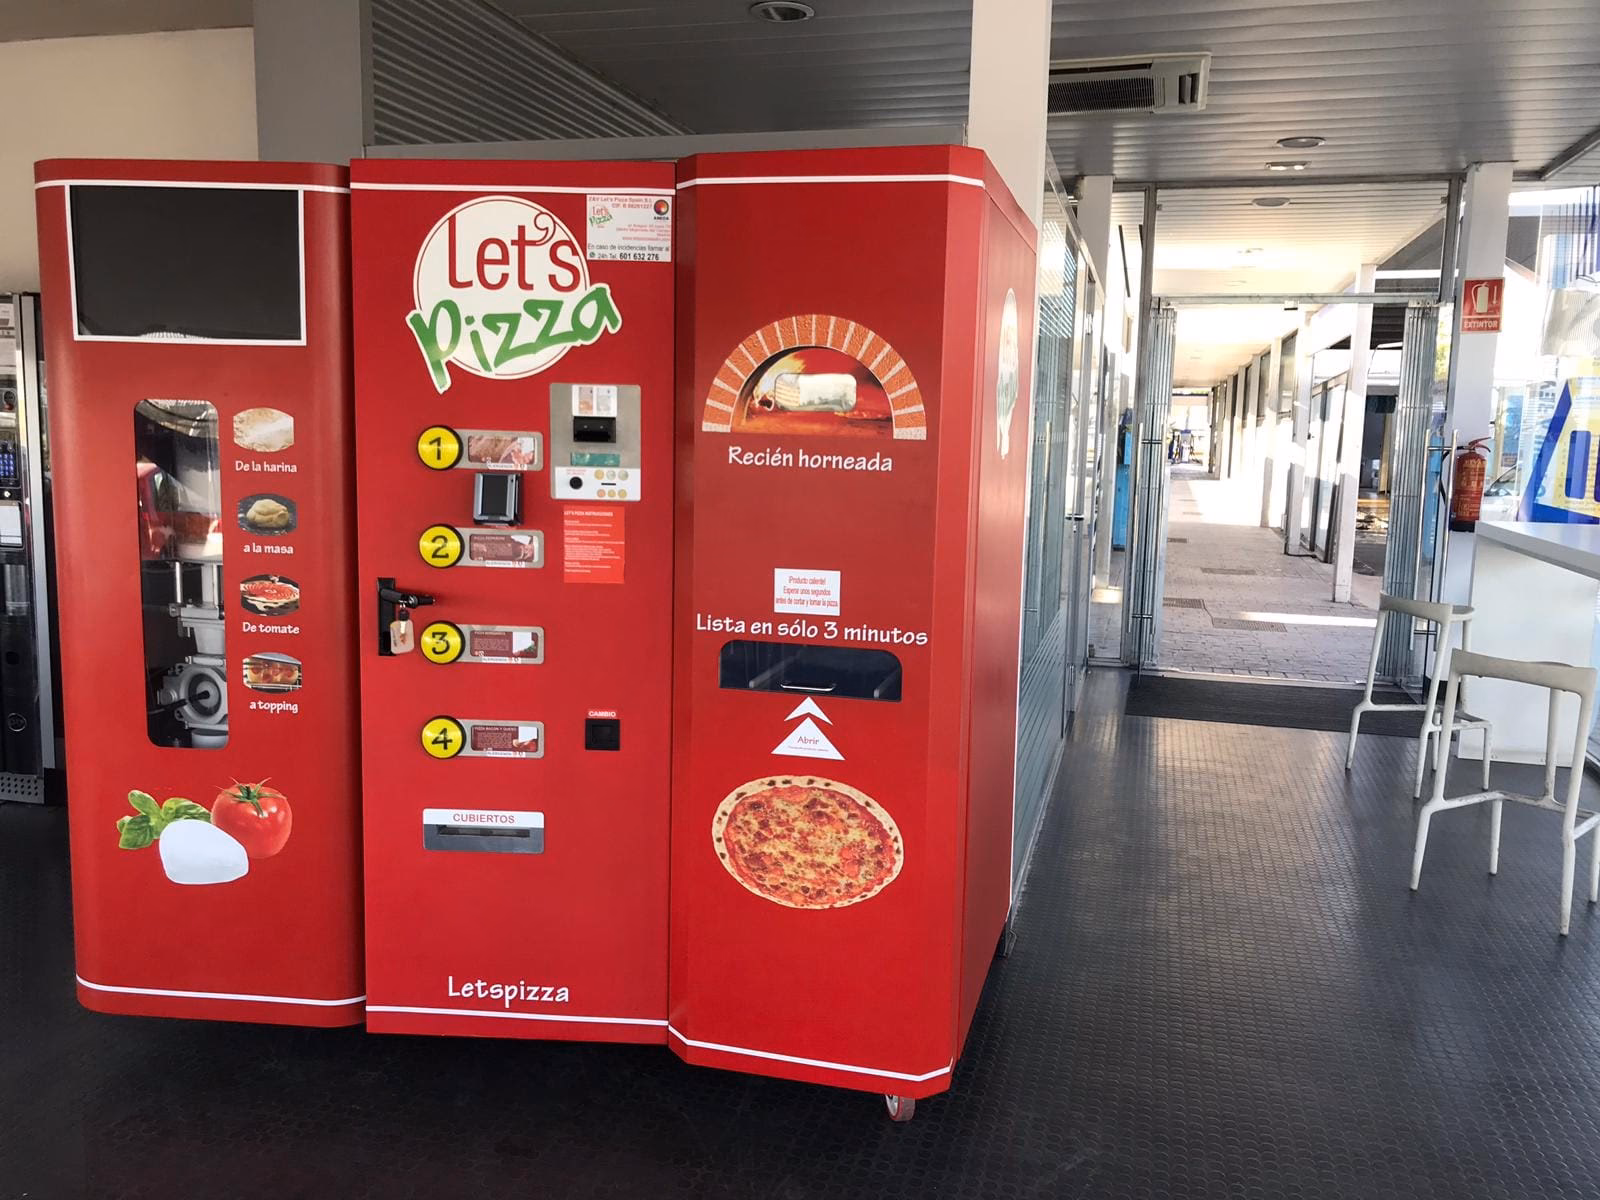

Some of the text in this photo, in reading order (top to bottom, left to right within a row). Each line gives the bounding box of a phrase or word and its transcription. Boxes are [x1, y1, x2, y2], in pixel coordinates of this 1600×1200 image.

[449, 211, 581, 293] Let's
[1464, 320, 1498, 328] EXTINTOR
[428, 436, 442, 460] 1
[728, 446, 892, 472] Recién horneada
[236, 460, 297, 473] De la harina
[244, 542, 294, 554] a la masa
[431, 534, 450, 559] 2
[242, 622, 300, 634] De tomate
[696, 613, 928, 645] Lista en sólo 3 minutos
[431, 632, 450, 655] 3
[250, 700, 298, 714] a topping
[432, 727, 453, 750] 4
[798, 736, 819, 745] Abrir
[452, 813, 515, 824] CUBIERTOS
[448, 976, 569, 1008] Letspizza
